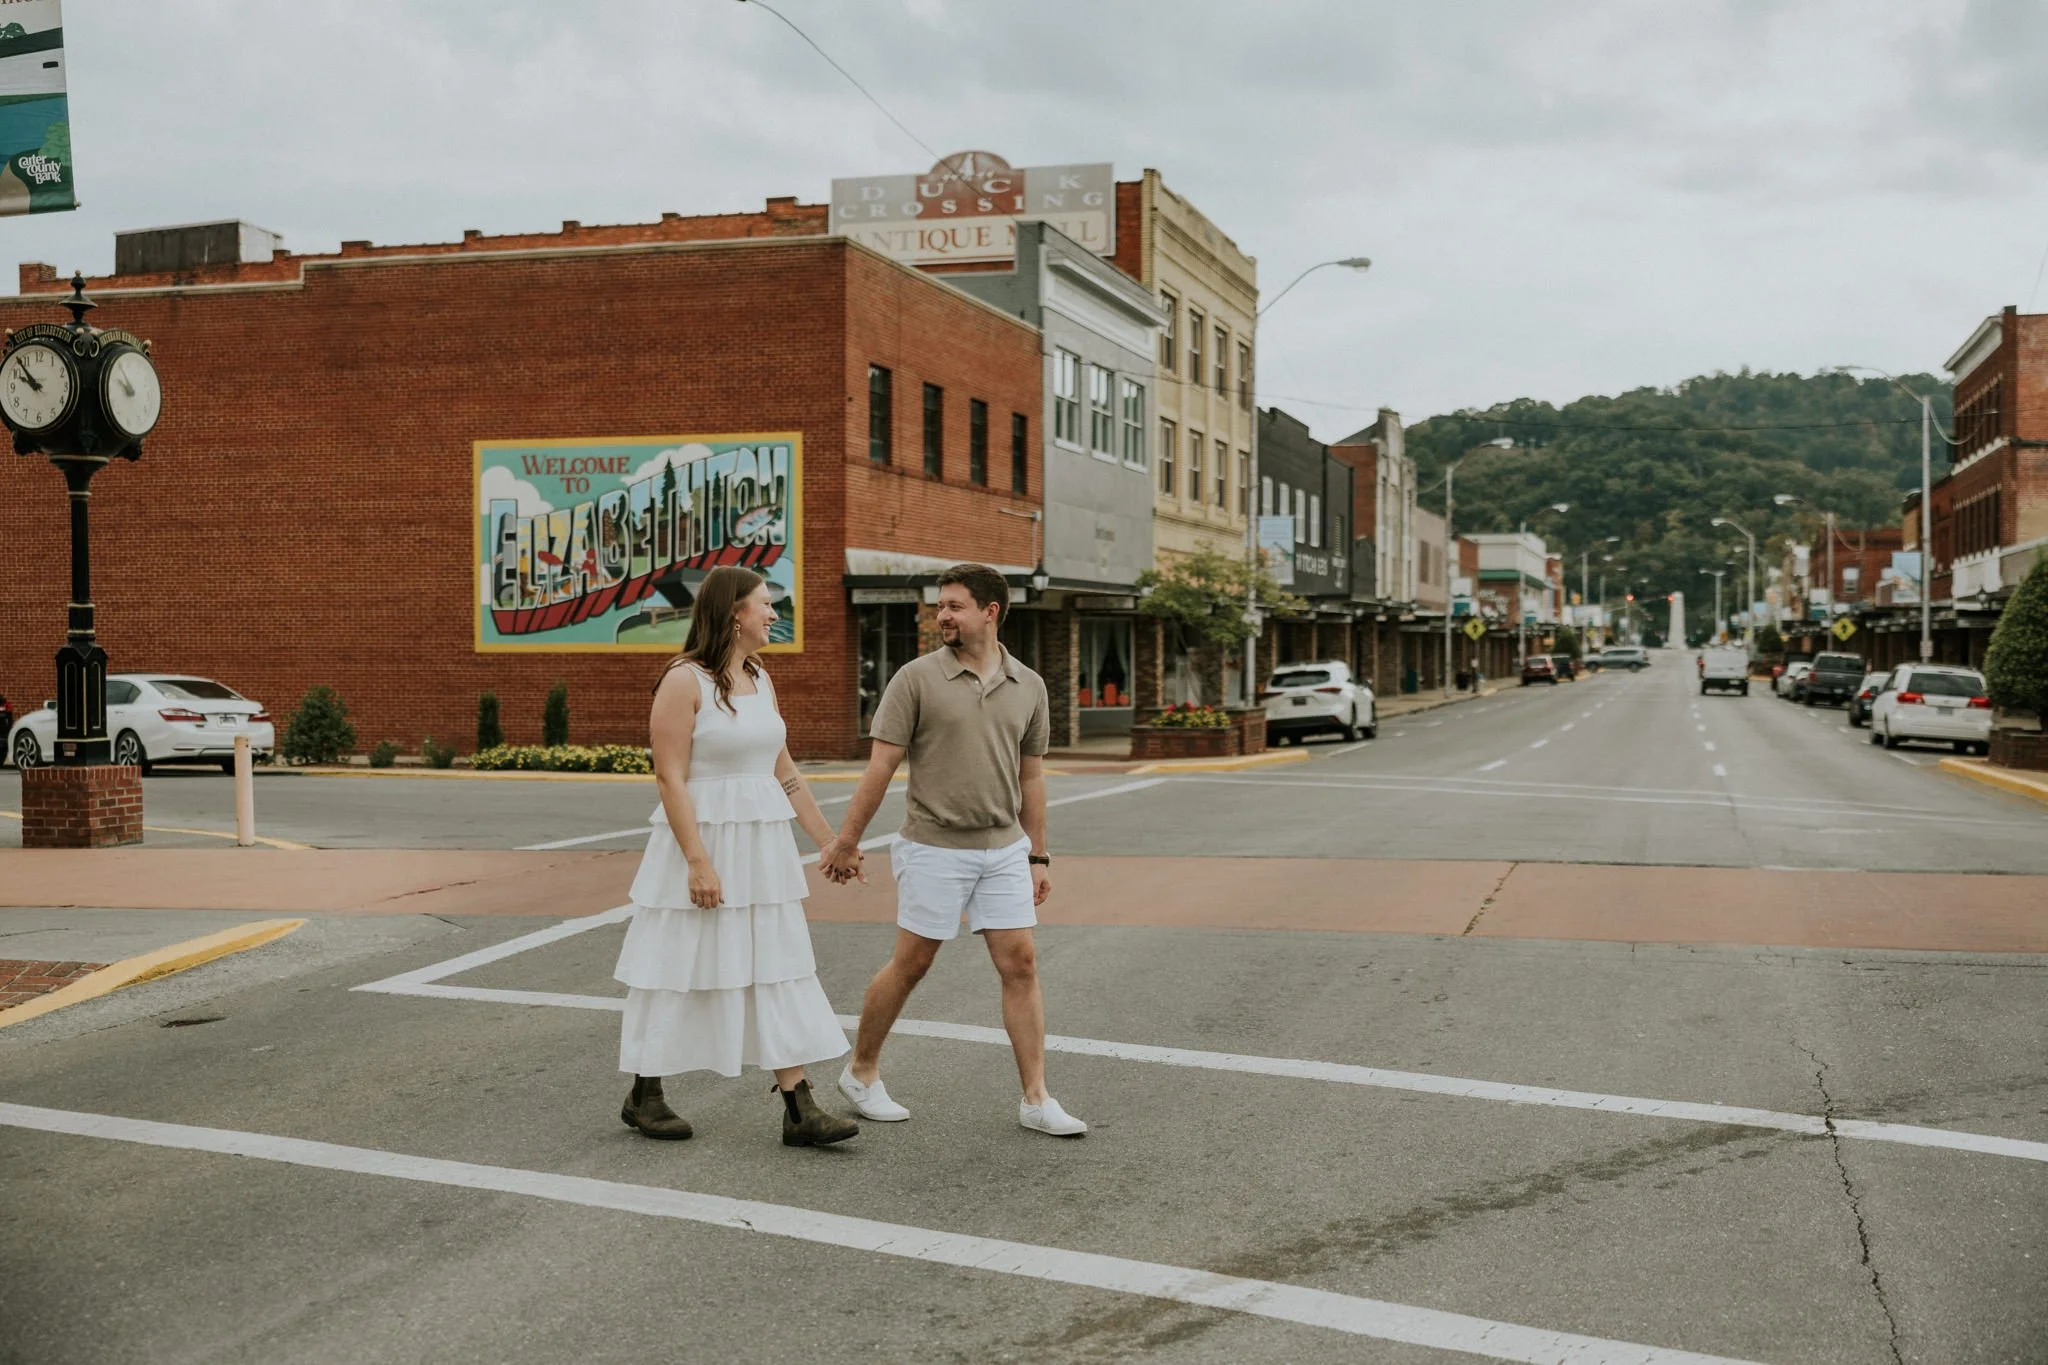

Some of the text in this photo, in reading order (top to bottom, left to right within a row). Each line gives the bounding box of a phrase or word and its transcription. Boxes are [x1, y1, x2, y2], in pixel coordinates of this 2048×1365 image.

[18, 154, 47, 169] Carter
[26, 161, 62, 177] County
[35, 172, 62, 184] Bank
[838, 191, 1104, 219] CROSSING
[14, 324, 73, 343] CITY OF ELIZABETHTON
[35, 351, 44, 363] 12
[60, 367, 65, 378] 2
[10, 382, 16, 393] 9
[64, 381, 69, 393] 3
[14, 397, 19, 408] 8
[59, 395, 65, 407] 4
[23, 408, 28, 420] 7
[36, 412, 42, 423] 6
[50, 407, 56, 419] 5
[521, 454, 633, 476] WELCOME
[560, 477, 591, 495] TO
[489, 446, 789, 613] ELIZABETHTON
